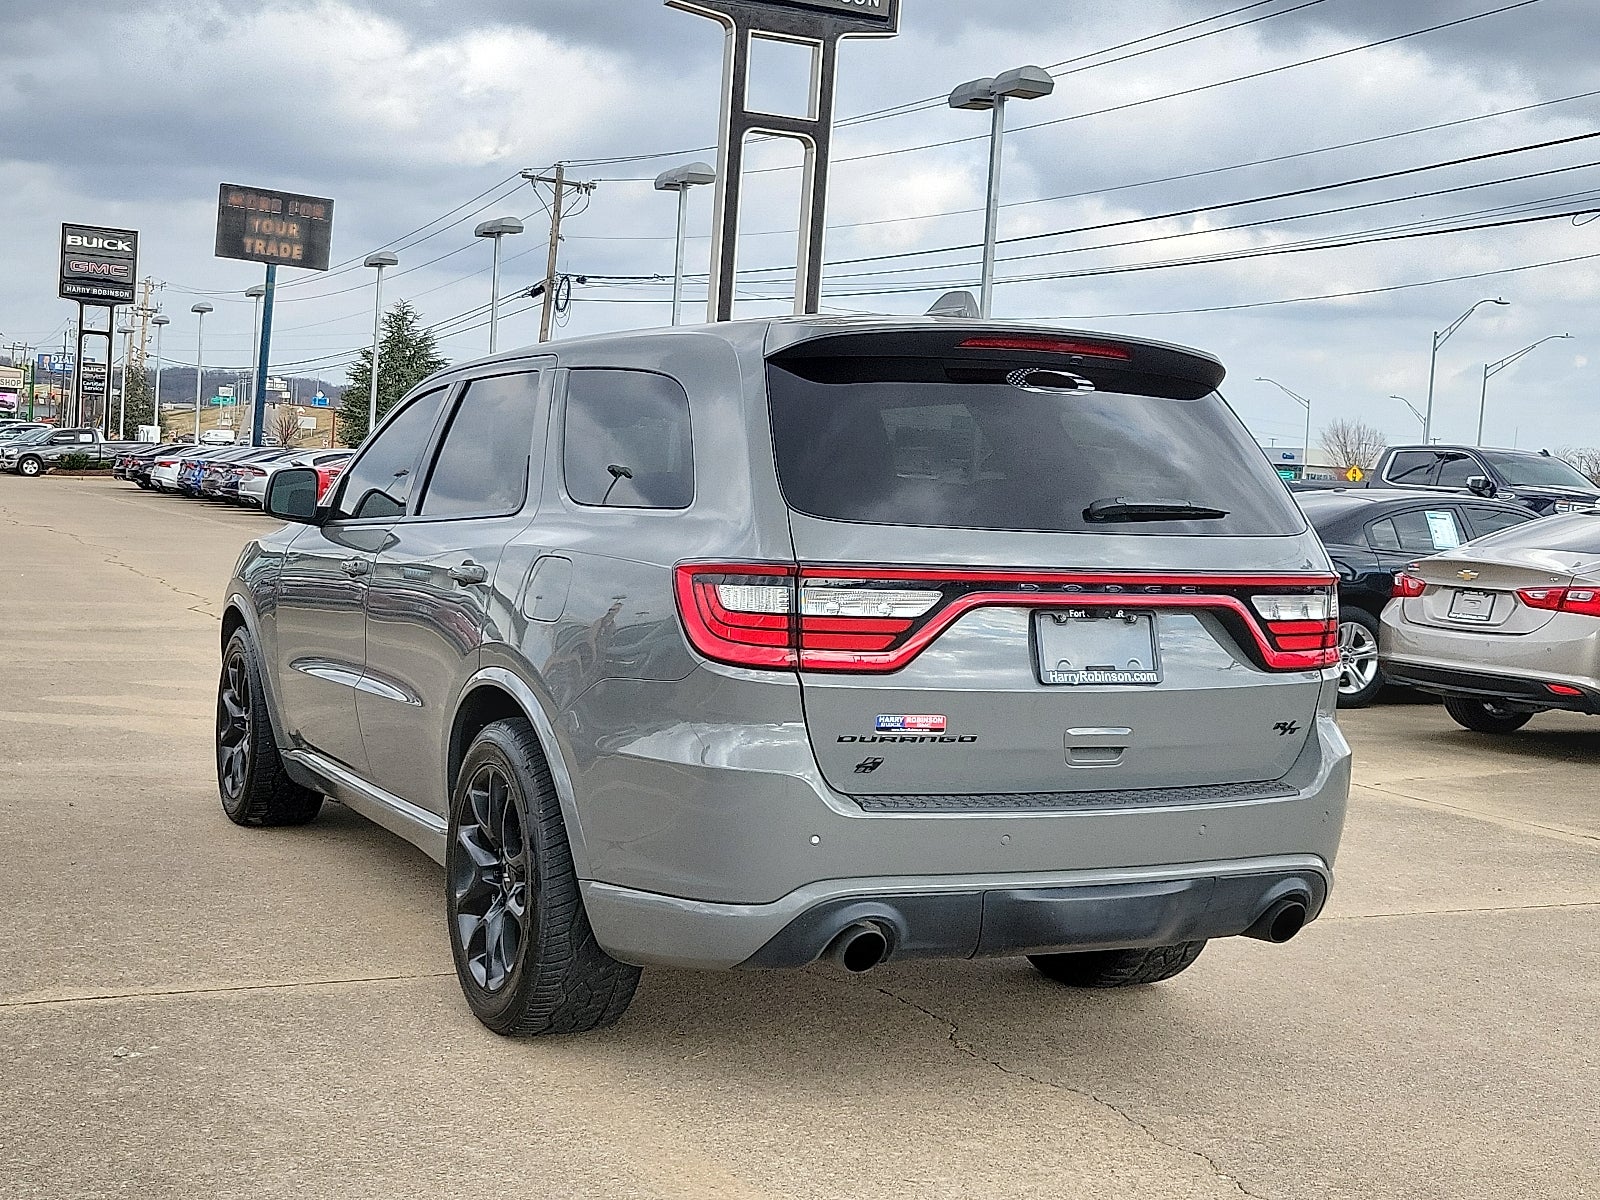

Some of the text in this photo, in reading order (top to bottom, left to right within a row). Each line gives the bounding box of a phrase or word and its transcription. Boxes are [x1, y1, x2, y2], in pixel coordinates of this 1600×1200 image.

[252, 217, 300, 238] YOUR
[67, 234, 133, 252] BUICK
[244, 237, 304, 260] TRADE
[69, 260, 129, 277] GMC
[66, 285, 130, 298] HARRY ROBINSON
[0, 378, 22, 387] SHOP
[1069, 609, 1086, 618] Fort
[1050, 671, 1157, 684] HarryRobinson.com
[1272, 720, 1302, 736] R/T
[837, 734, 978, 743] DURANGO
